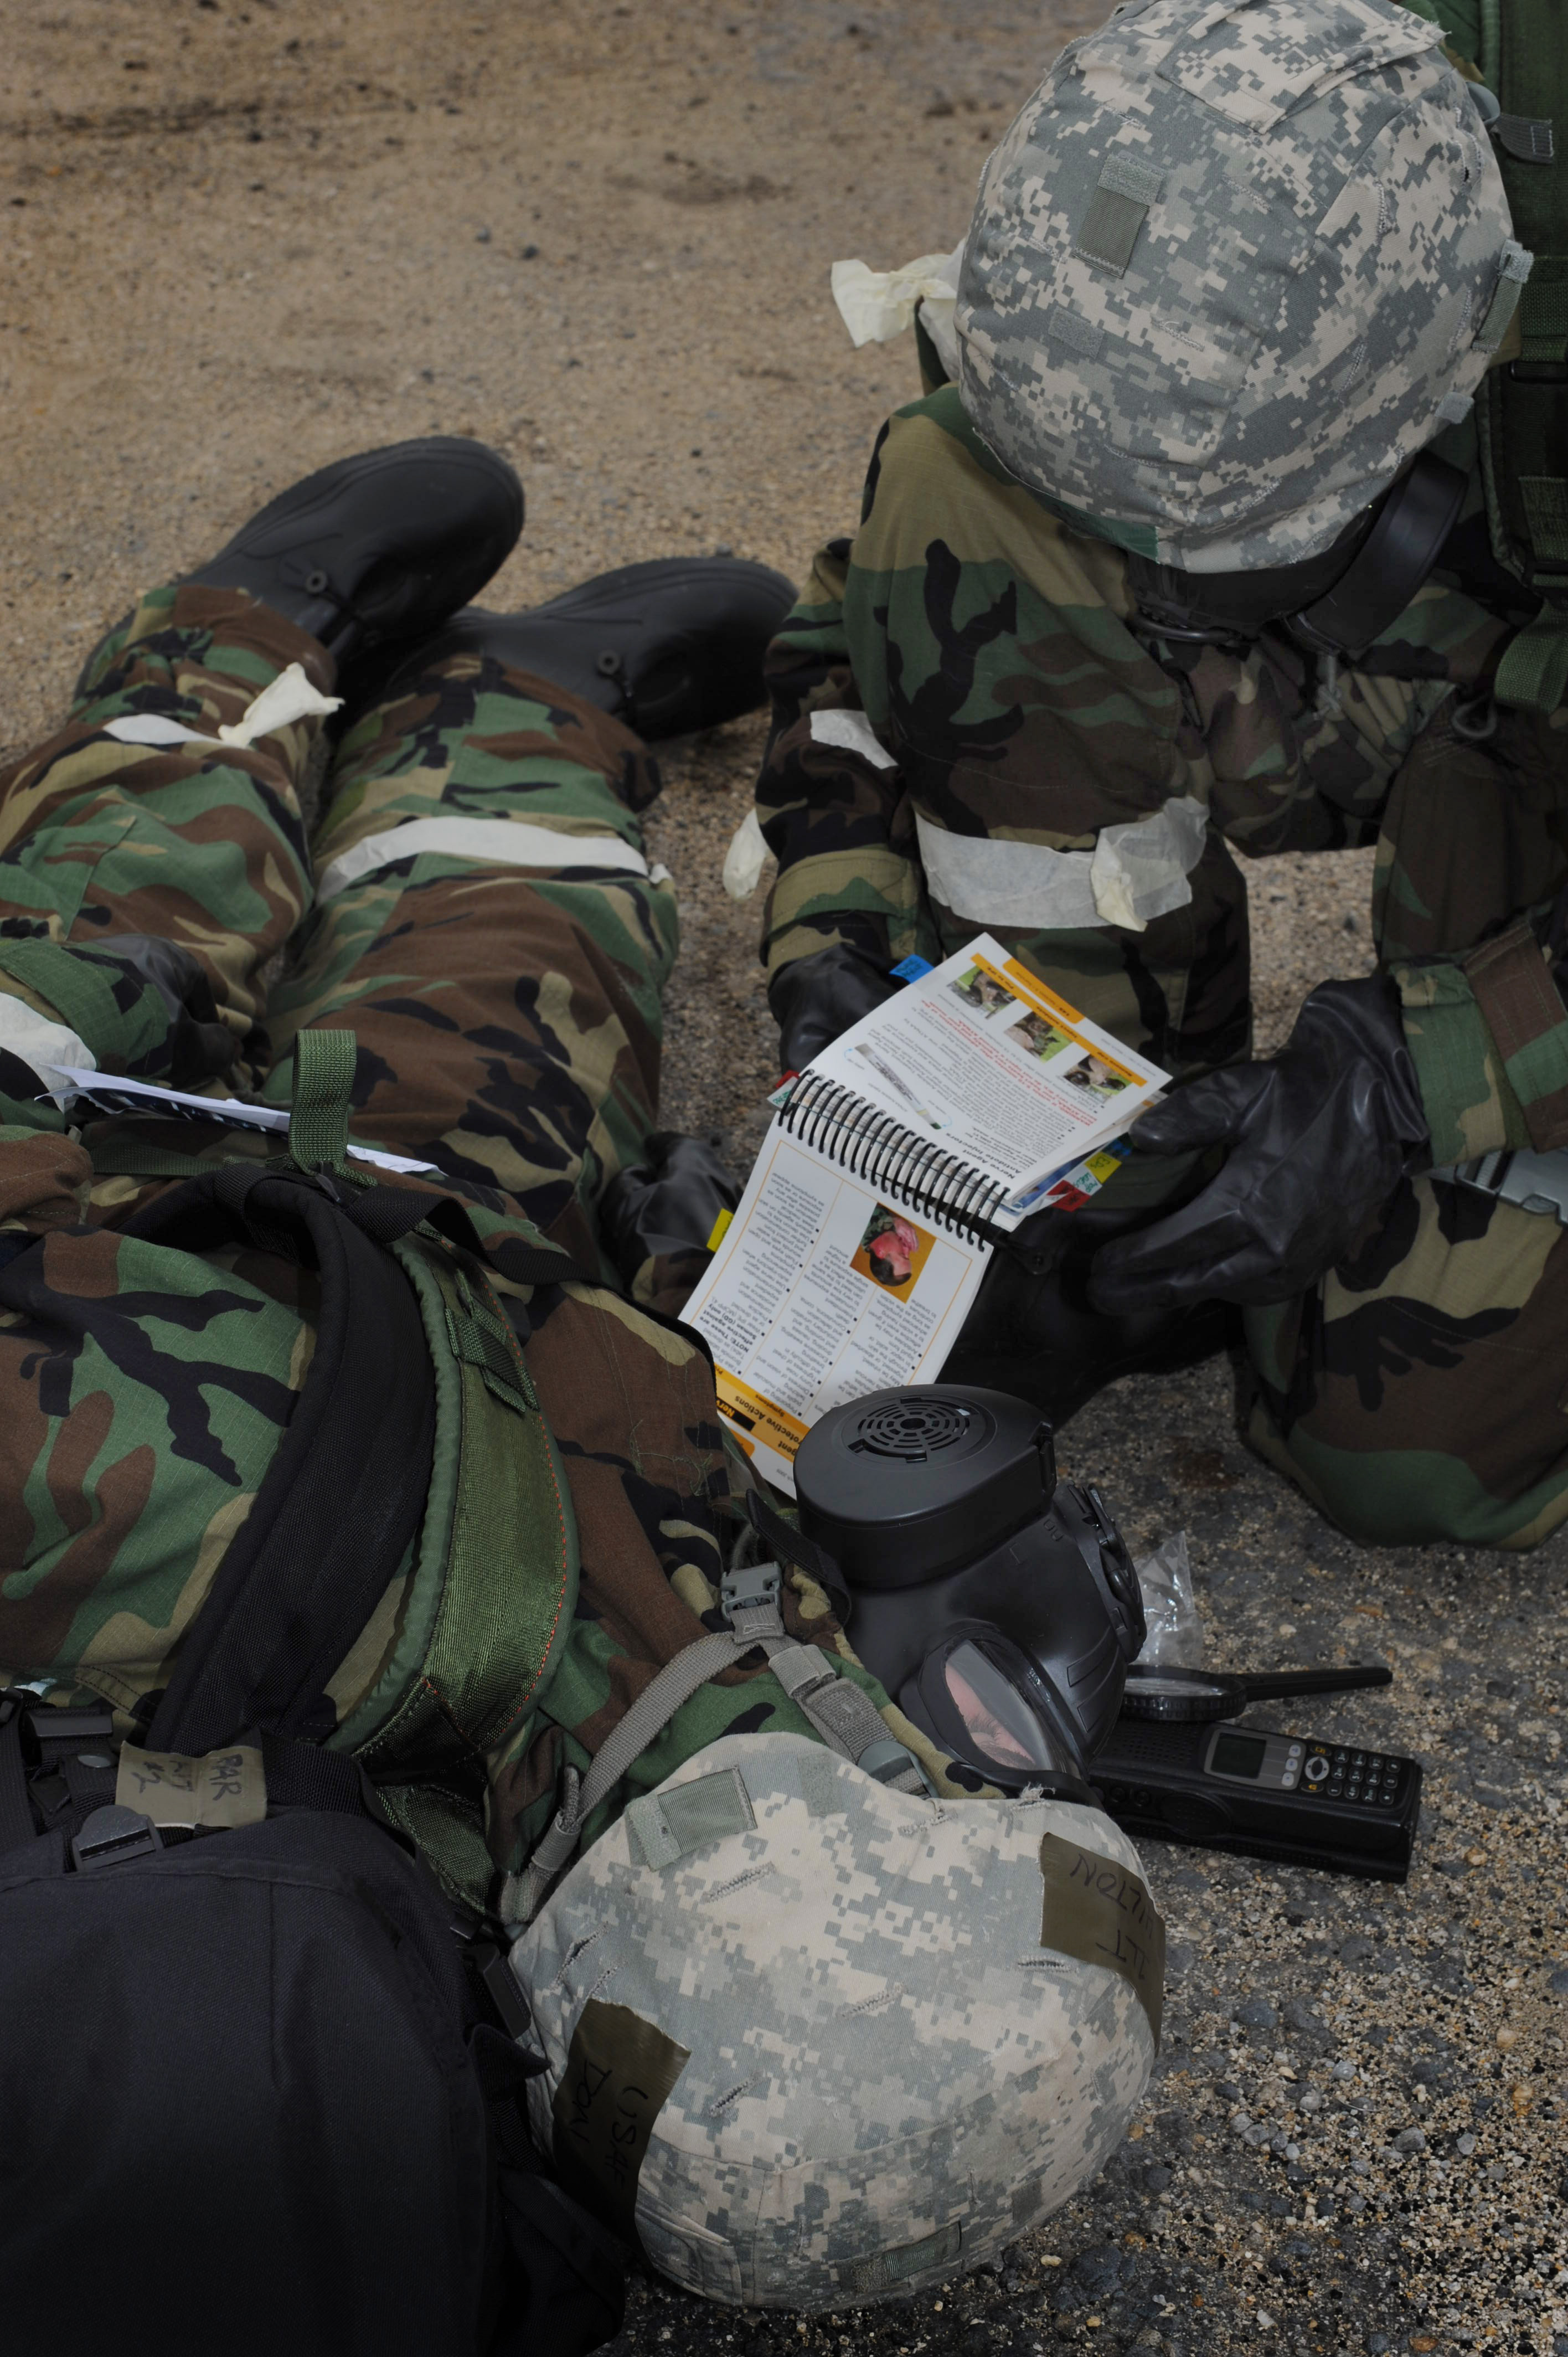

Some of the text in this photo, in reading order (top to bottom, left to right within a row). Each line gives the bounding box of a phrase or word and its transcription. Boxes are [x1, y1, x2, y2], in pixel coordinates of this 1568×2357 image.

[946, 1133, 1022, 1174] Antidote Injectors
[962, 1149, 1015, 1179] Nerve Agent
[745, 1259, 760, 1271] agent
[760, 1270, 775, 1281] nerve
[699, 1316, 710, 1324] are
[703, 1310, 726, 1326] against
[708, 1303, 756, 1340] Soman (GD) only
[710, 1324, 728, 1339] These
[726, 1326, 753, 1345] effective
[730, 1337, 749, 1352] NOTE:
[803, 1342, 828, 1363] Excessive
[756, 1355, 766, 1363] and
[772, 1348, 787, 1360] chest
[801, 1349, 826, 1369] breathing
[766, 1362, 781, 1373] vision
[786, 1367, 798, 1377] nose
[810, 1366, 821, 1375] and
[752, 1372, 776, 1389] muscular
[788, 1377, 810, 1396] Dimness
[776, 1387, 786, 1396] and
[784, 1382, 807, 1401] twitching
[714, 1399, 735, 1416] Nerv
[755, 1394, 785, 1418] Symptoms
[770, 1391, 798, 1414] Pinpointing
[735, 1396, 803, 1446] rotective Actions
[777, 1440, 798, 1456] gent
[605, 2086, 648, 2190] USAF
